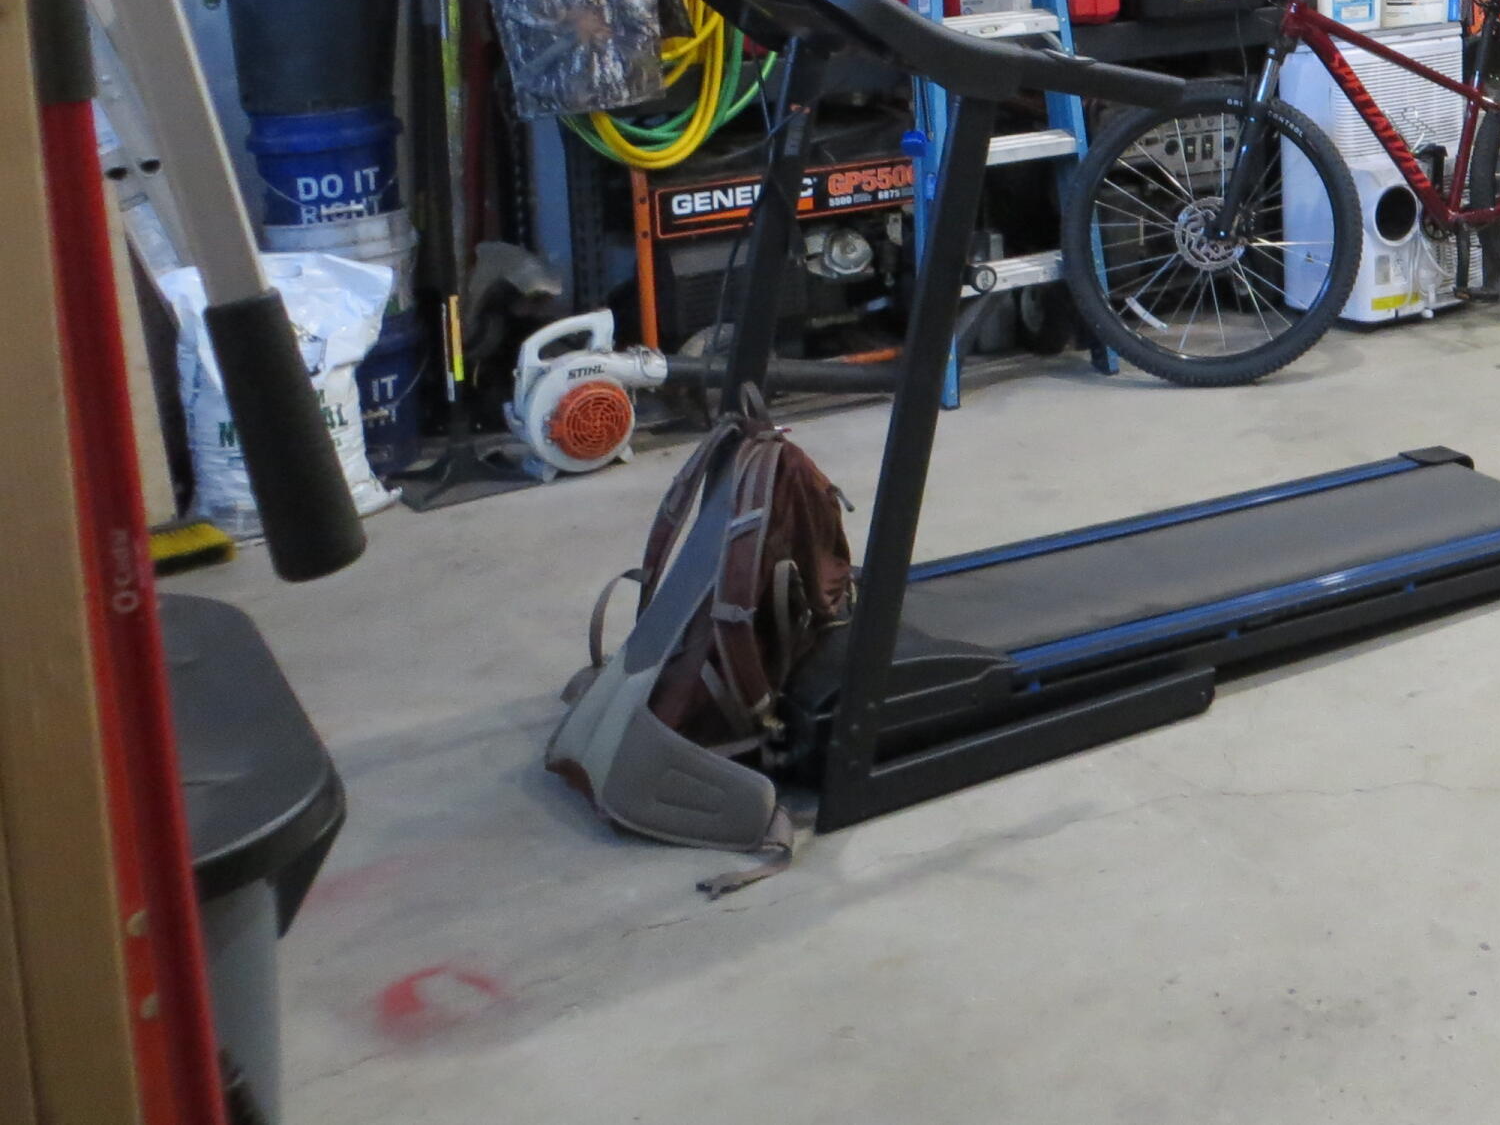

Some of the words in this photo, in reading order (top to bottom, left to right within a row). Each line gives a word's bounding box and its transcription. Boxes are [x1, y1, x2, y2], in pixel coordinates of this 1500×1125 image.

[296, 173, 344, 202] DO
[353, 166, 380, 194] IT
[567, 363, 605, 380] STIHL
